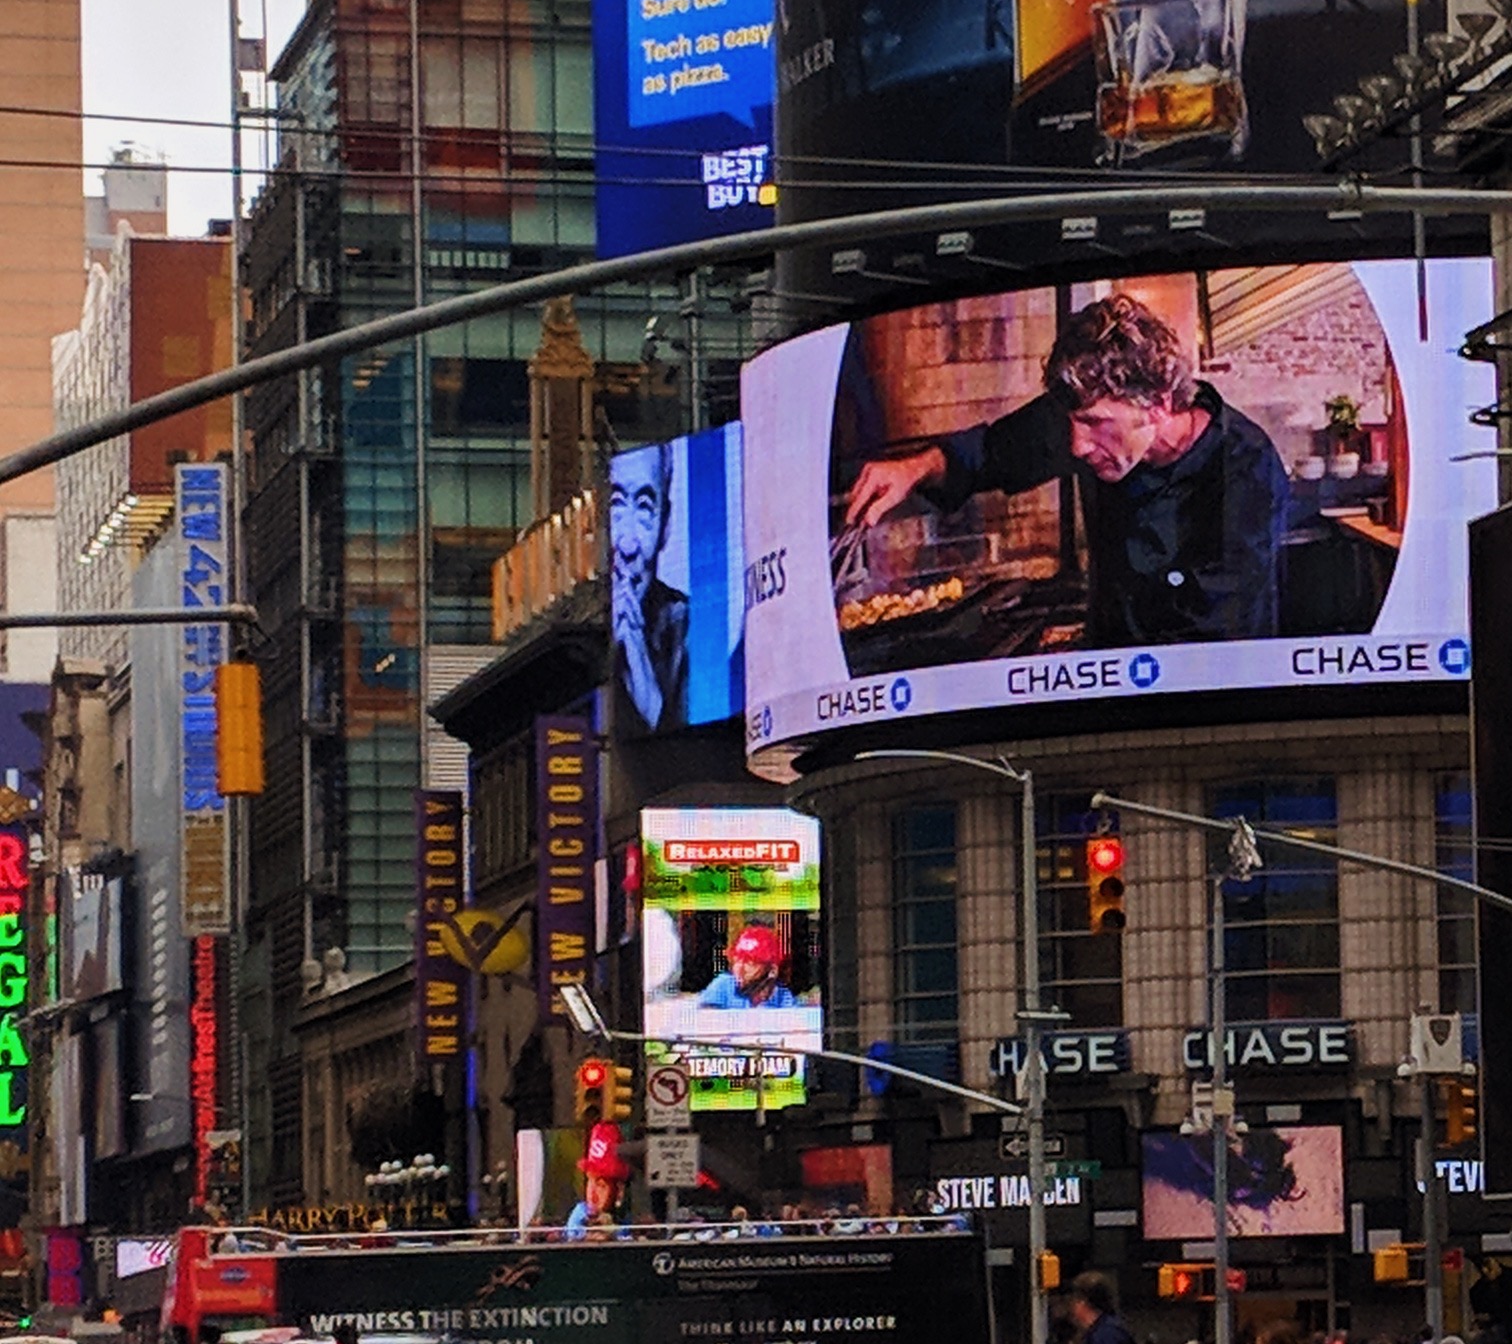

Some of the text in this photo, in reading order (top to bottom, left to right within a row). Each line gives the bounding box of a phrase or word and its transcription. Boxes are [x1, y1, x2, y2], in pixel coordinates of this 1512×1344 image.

[641, 21, 774, 64] Tech as easy
[642, 62, 730, 96] as pizza.
[702, 145, 768, 183] BEST
[707, 175, 760, 209] BUY
[181, 469, 222, 541] NEW
[1291, 642, 1429, 676] CHASE
[1007, 661, 1123, 695] CHASE
[817, 683, 885, 724] CHASE
[548, 728, 585, 905] VICTORY
[426, 980, 458, 1055] NEW
[989, 1034, 1119, 1077] HSE
[1182, 1025, 1349, 1069] CHASE
[937, 1175, 1081, 1207] STEVE MAEN
[1417, 1160, 1485, 1194] TEV
[310, 1305, 609, 1333] WITNESS THE EXTINCTION
[812, 1315, 897, 1332] EXPLORER
